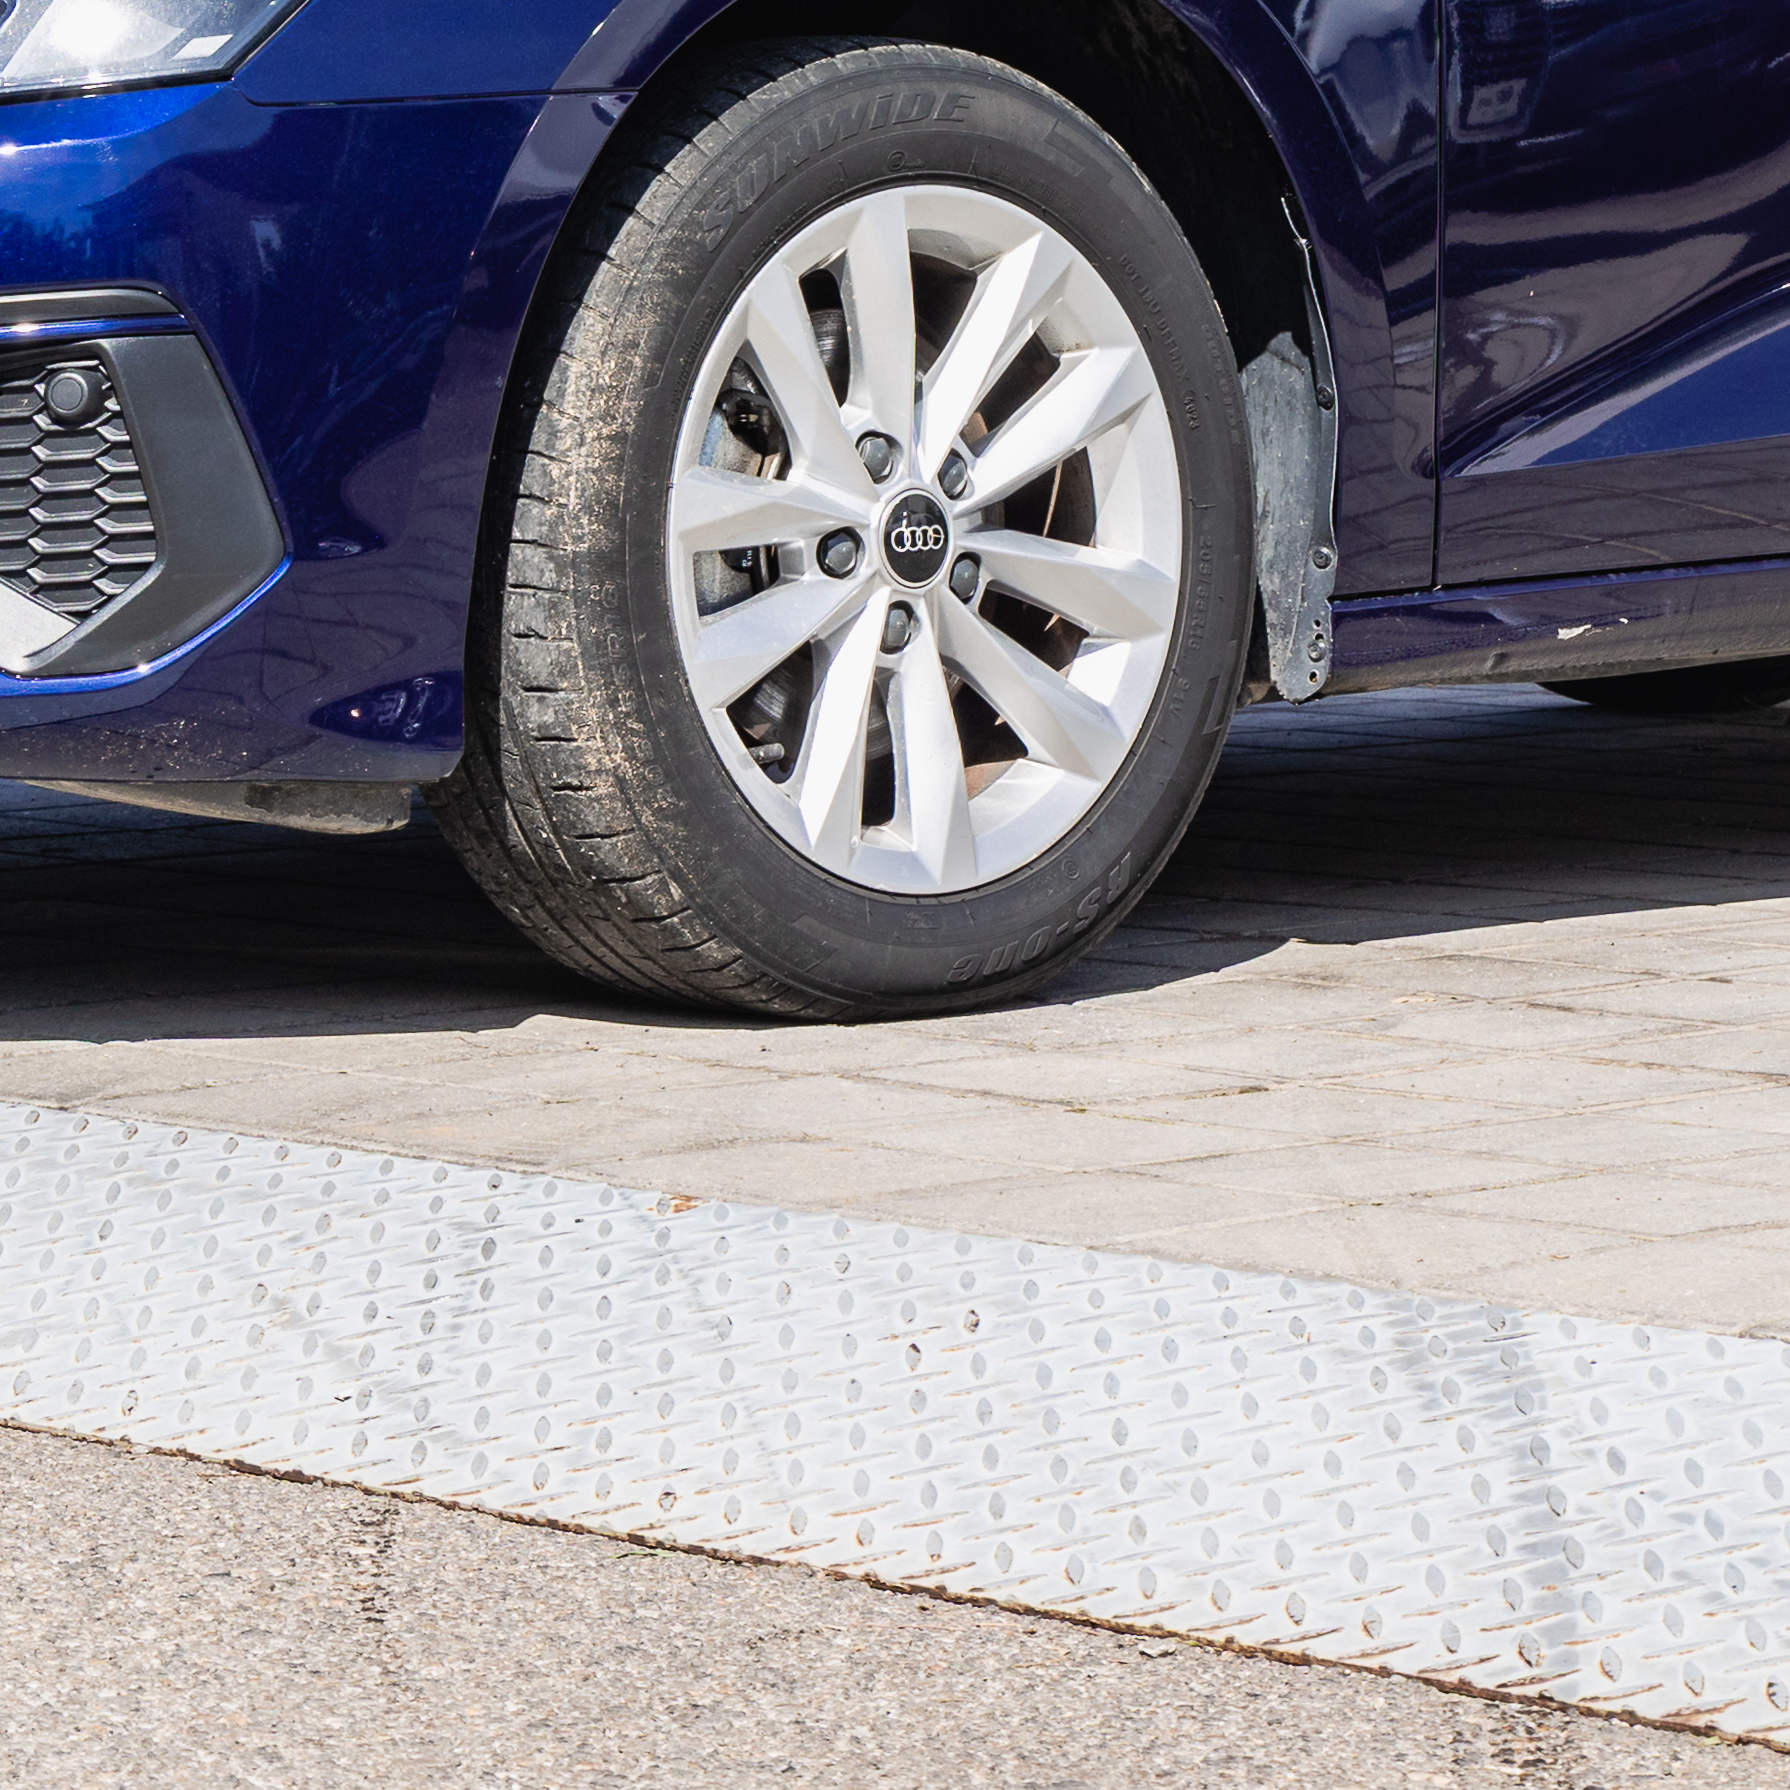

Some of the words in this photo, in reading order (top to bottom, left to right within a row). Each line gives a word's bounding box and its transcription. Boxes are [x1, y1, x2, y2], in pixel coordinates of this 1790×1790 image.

[703, 92, 976, 254] SUNWIDE
[1118, 253, 1141, 283] DOT
[1189, 535, 1212, 652] 205/55R16
